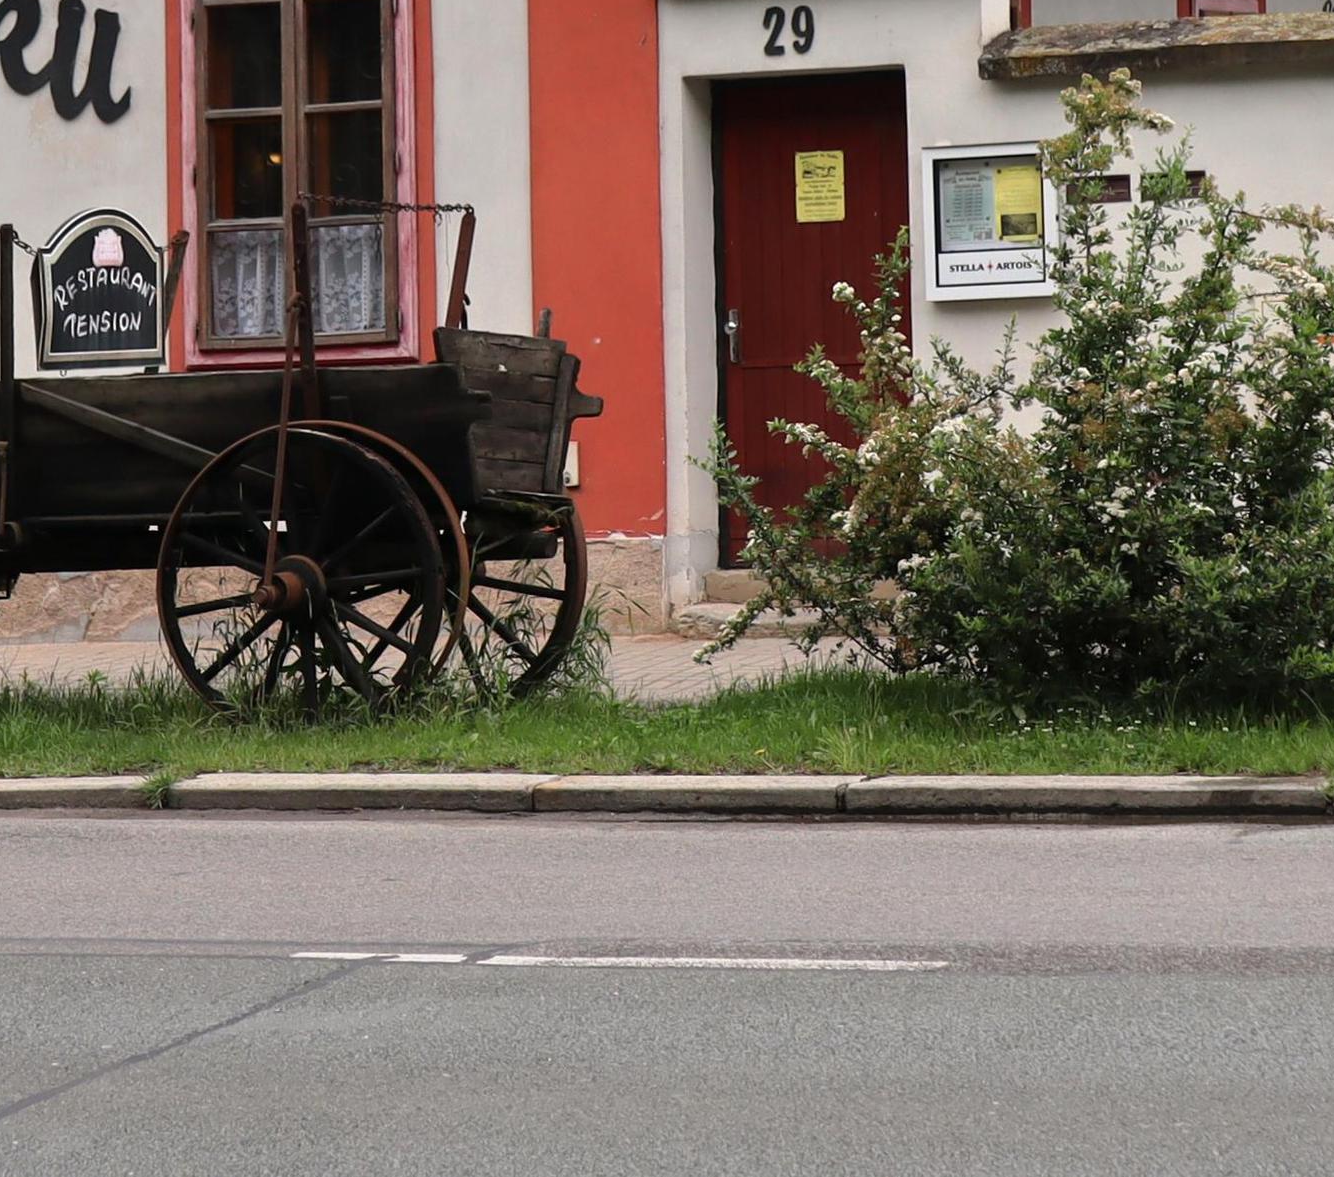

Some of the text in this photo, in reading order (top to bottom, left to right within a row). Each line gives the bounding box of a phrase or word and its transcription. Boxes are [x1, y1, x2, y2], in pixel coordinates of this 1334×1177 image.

[762, 5, 815, 56] 29
[54, 266, 156, 311] RESTAURANT
[949, 261, 1033, 272] STELLA ARTOIS
